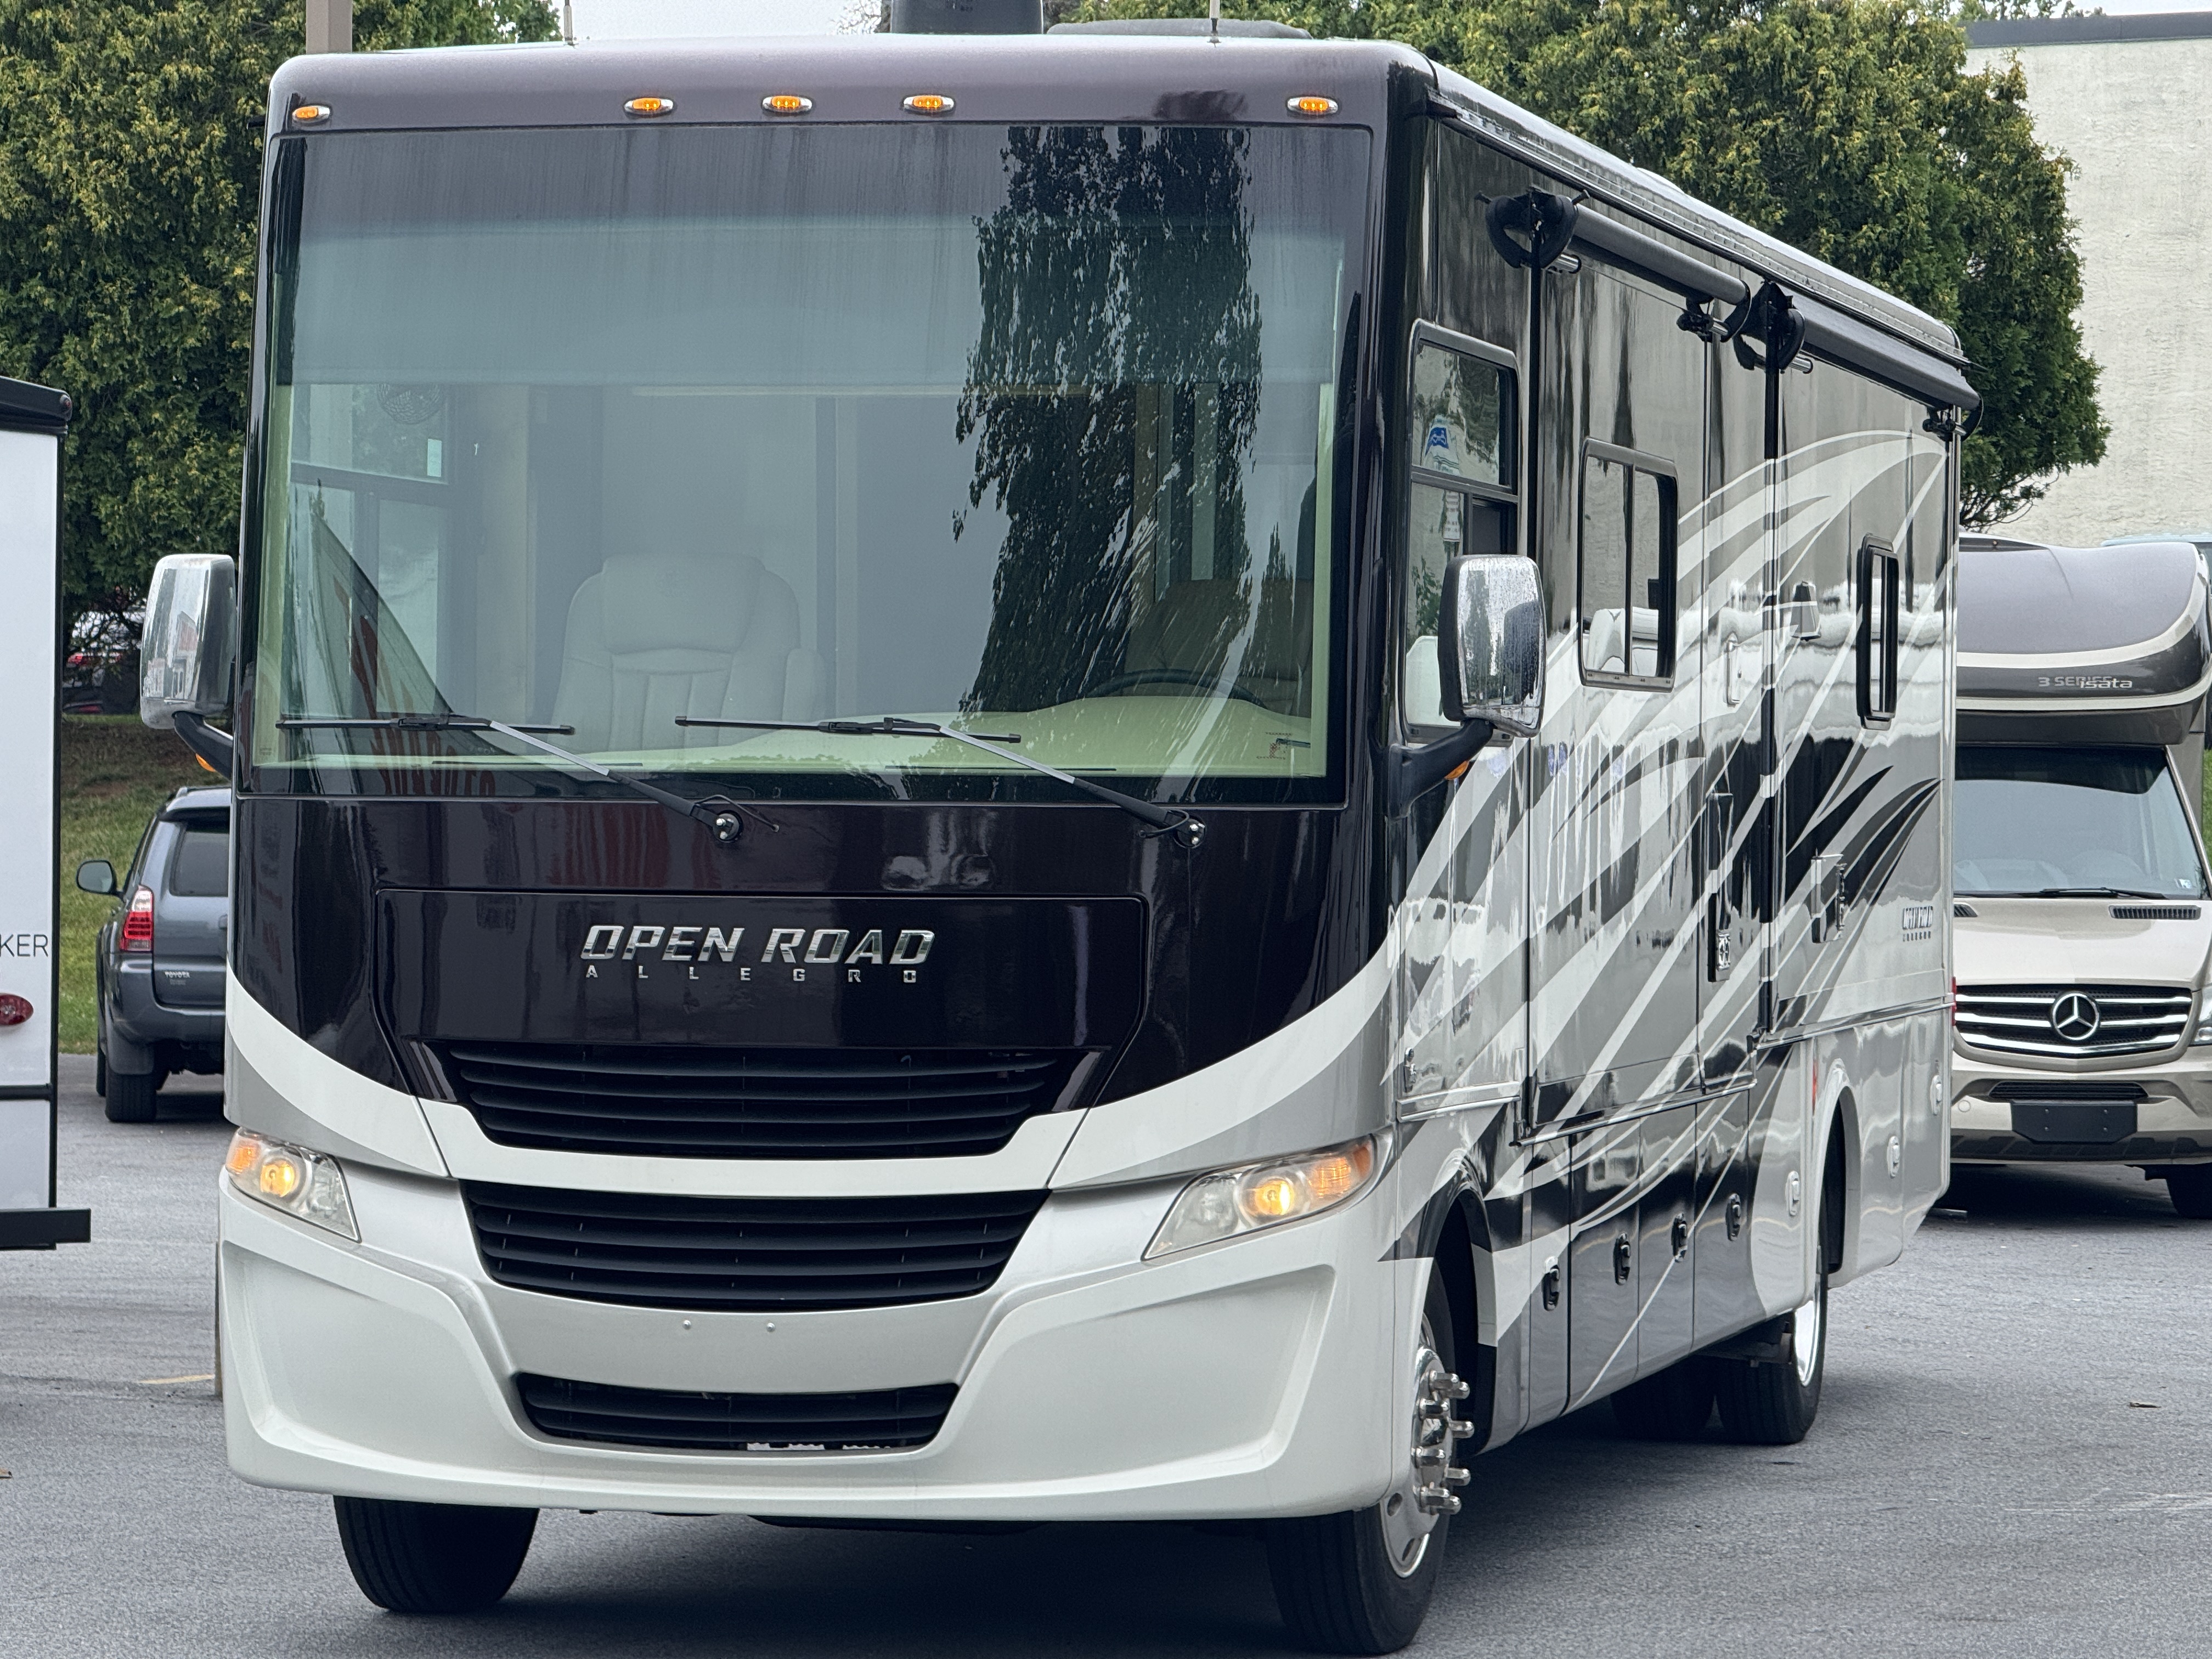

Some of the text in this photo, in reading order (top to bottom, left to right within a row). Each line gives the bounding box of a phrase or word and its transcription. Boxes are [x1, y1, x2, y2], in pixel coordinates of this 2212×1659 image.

[2038, 677, 2050, 687] 3
[2080, 678, 2133, 689] isata
[580, 924, 936, 964] OPEN ROAD
[585, 965, 917, 984] ALLEGRO
